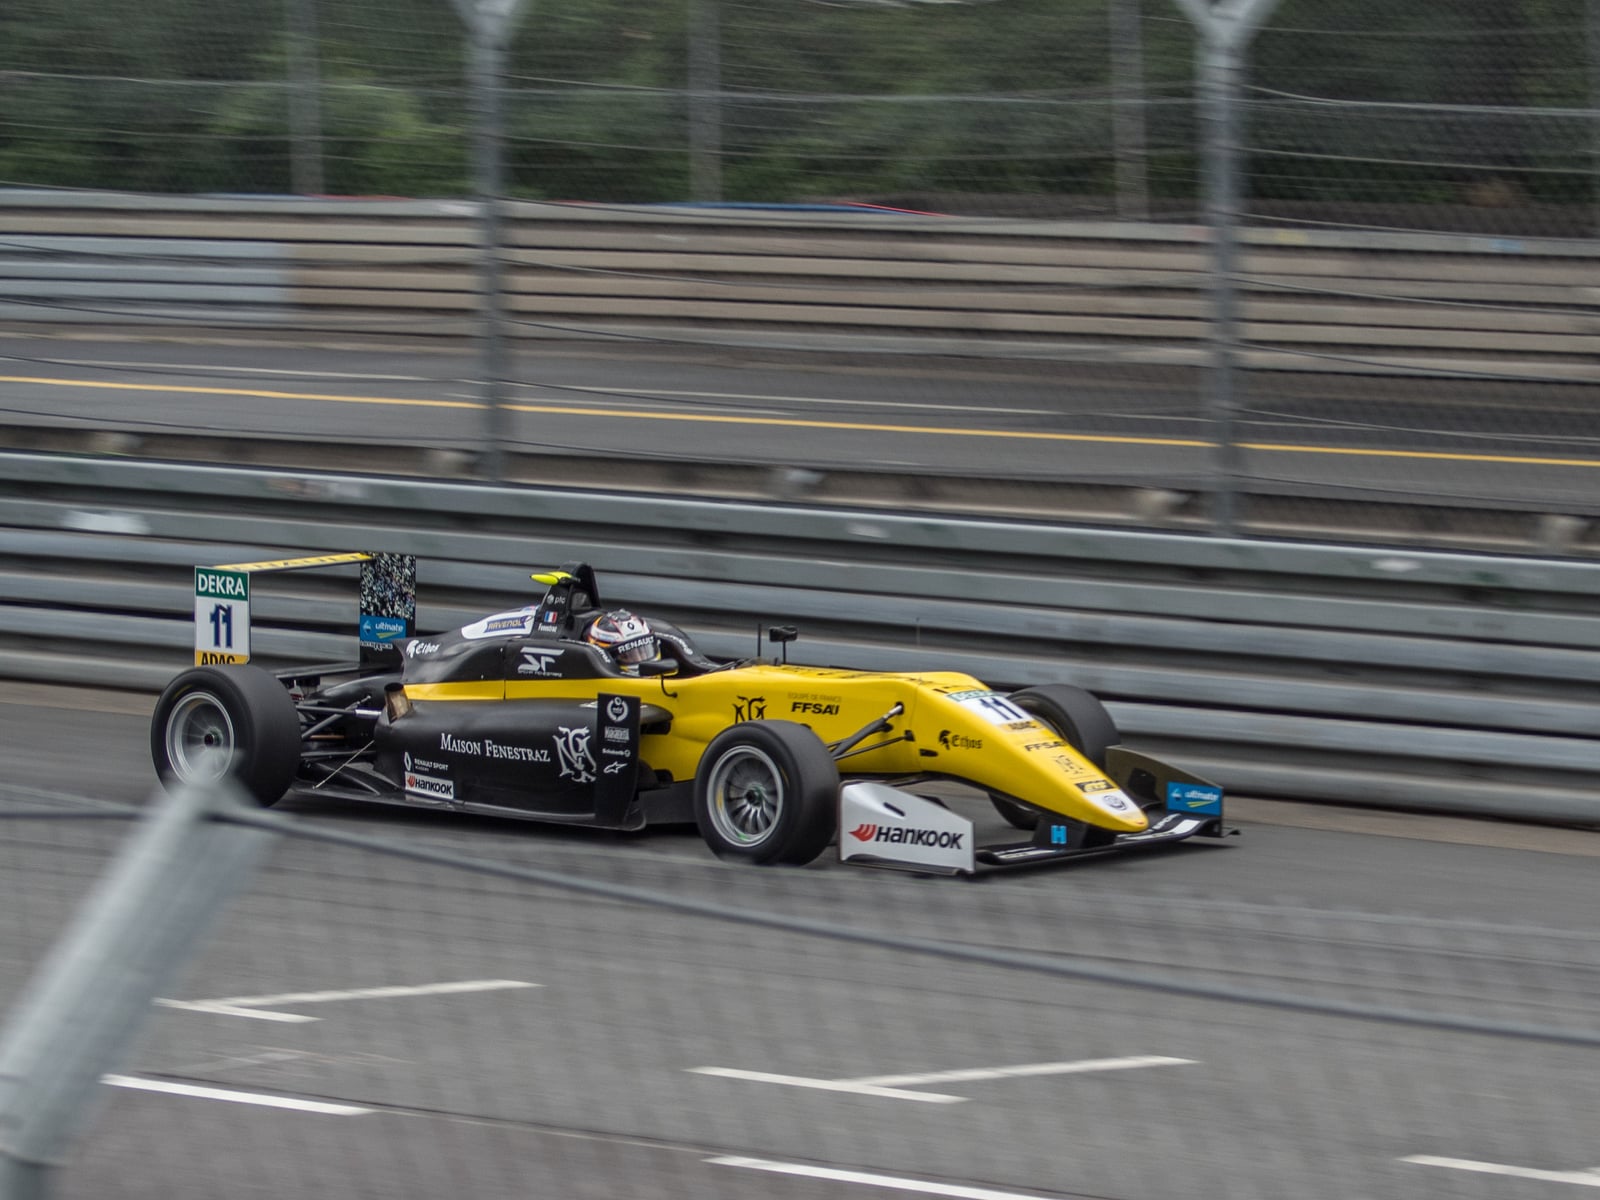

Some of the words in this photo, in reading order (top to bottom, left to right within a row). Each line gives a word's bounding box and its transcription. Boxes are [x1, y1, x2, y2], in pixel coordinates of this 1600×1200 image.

[197, 574, 246, 597] DEKRA
[209, 603, 233, 649] 11
[617, 635, 655, 653] RENAULT
[978, 697, 1023, 721] 11
